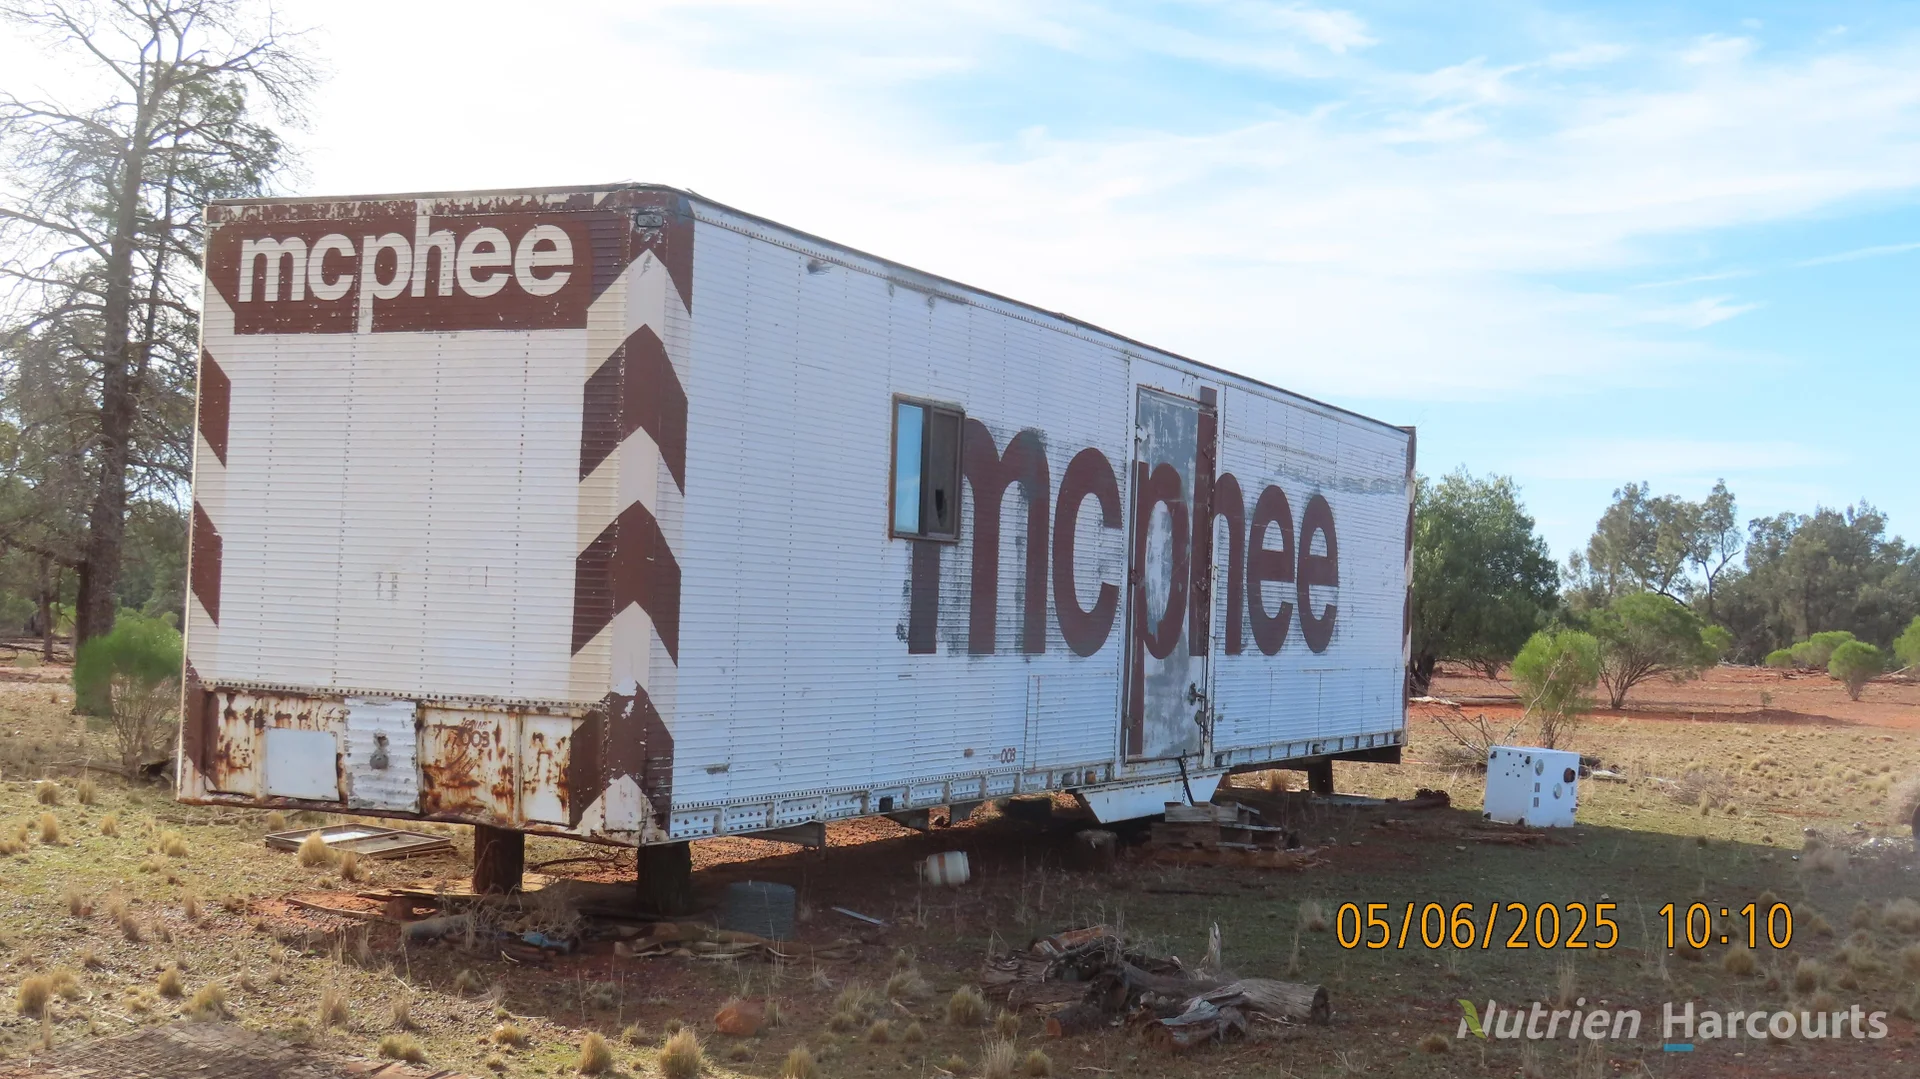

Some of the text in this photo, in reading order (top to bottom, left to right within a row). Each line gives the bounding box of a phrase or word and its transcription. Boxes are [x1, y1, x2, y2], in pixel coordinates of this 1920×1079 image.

[237, 199, 575, 334] mcphee
[908, 386, 1339, 755] mcphee
[1000, 747, 1017, 764] 003
